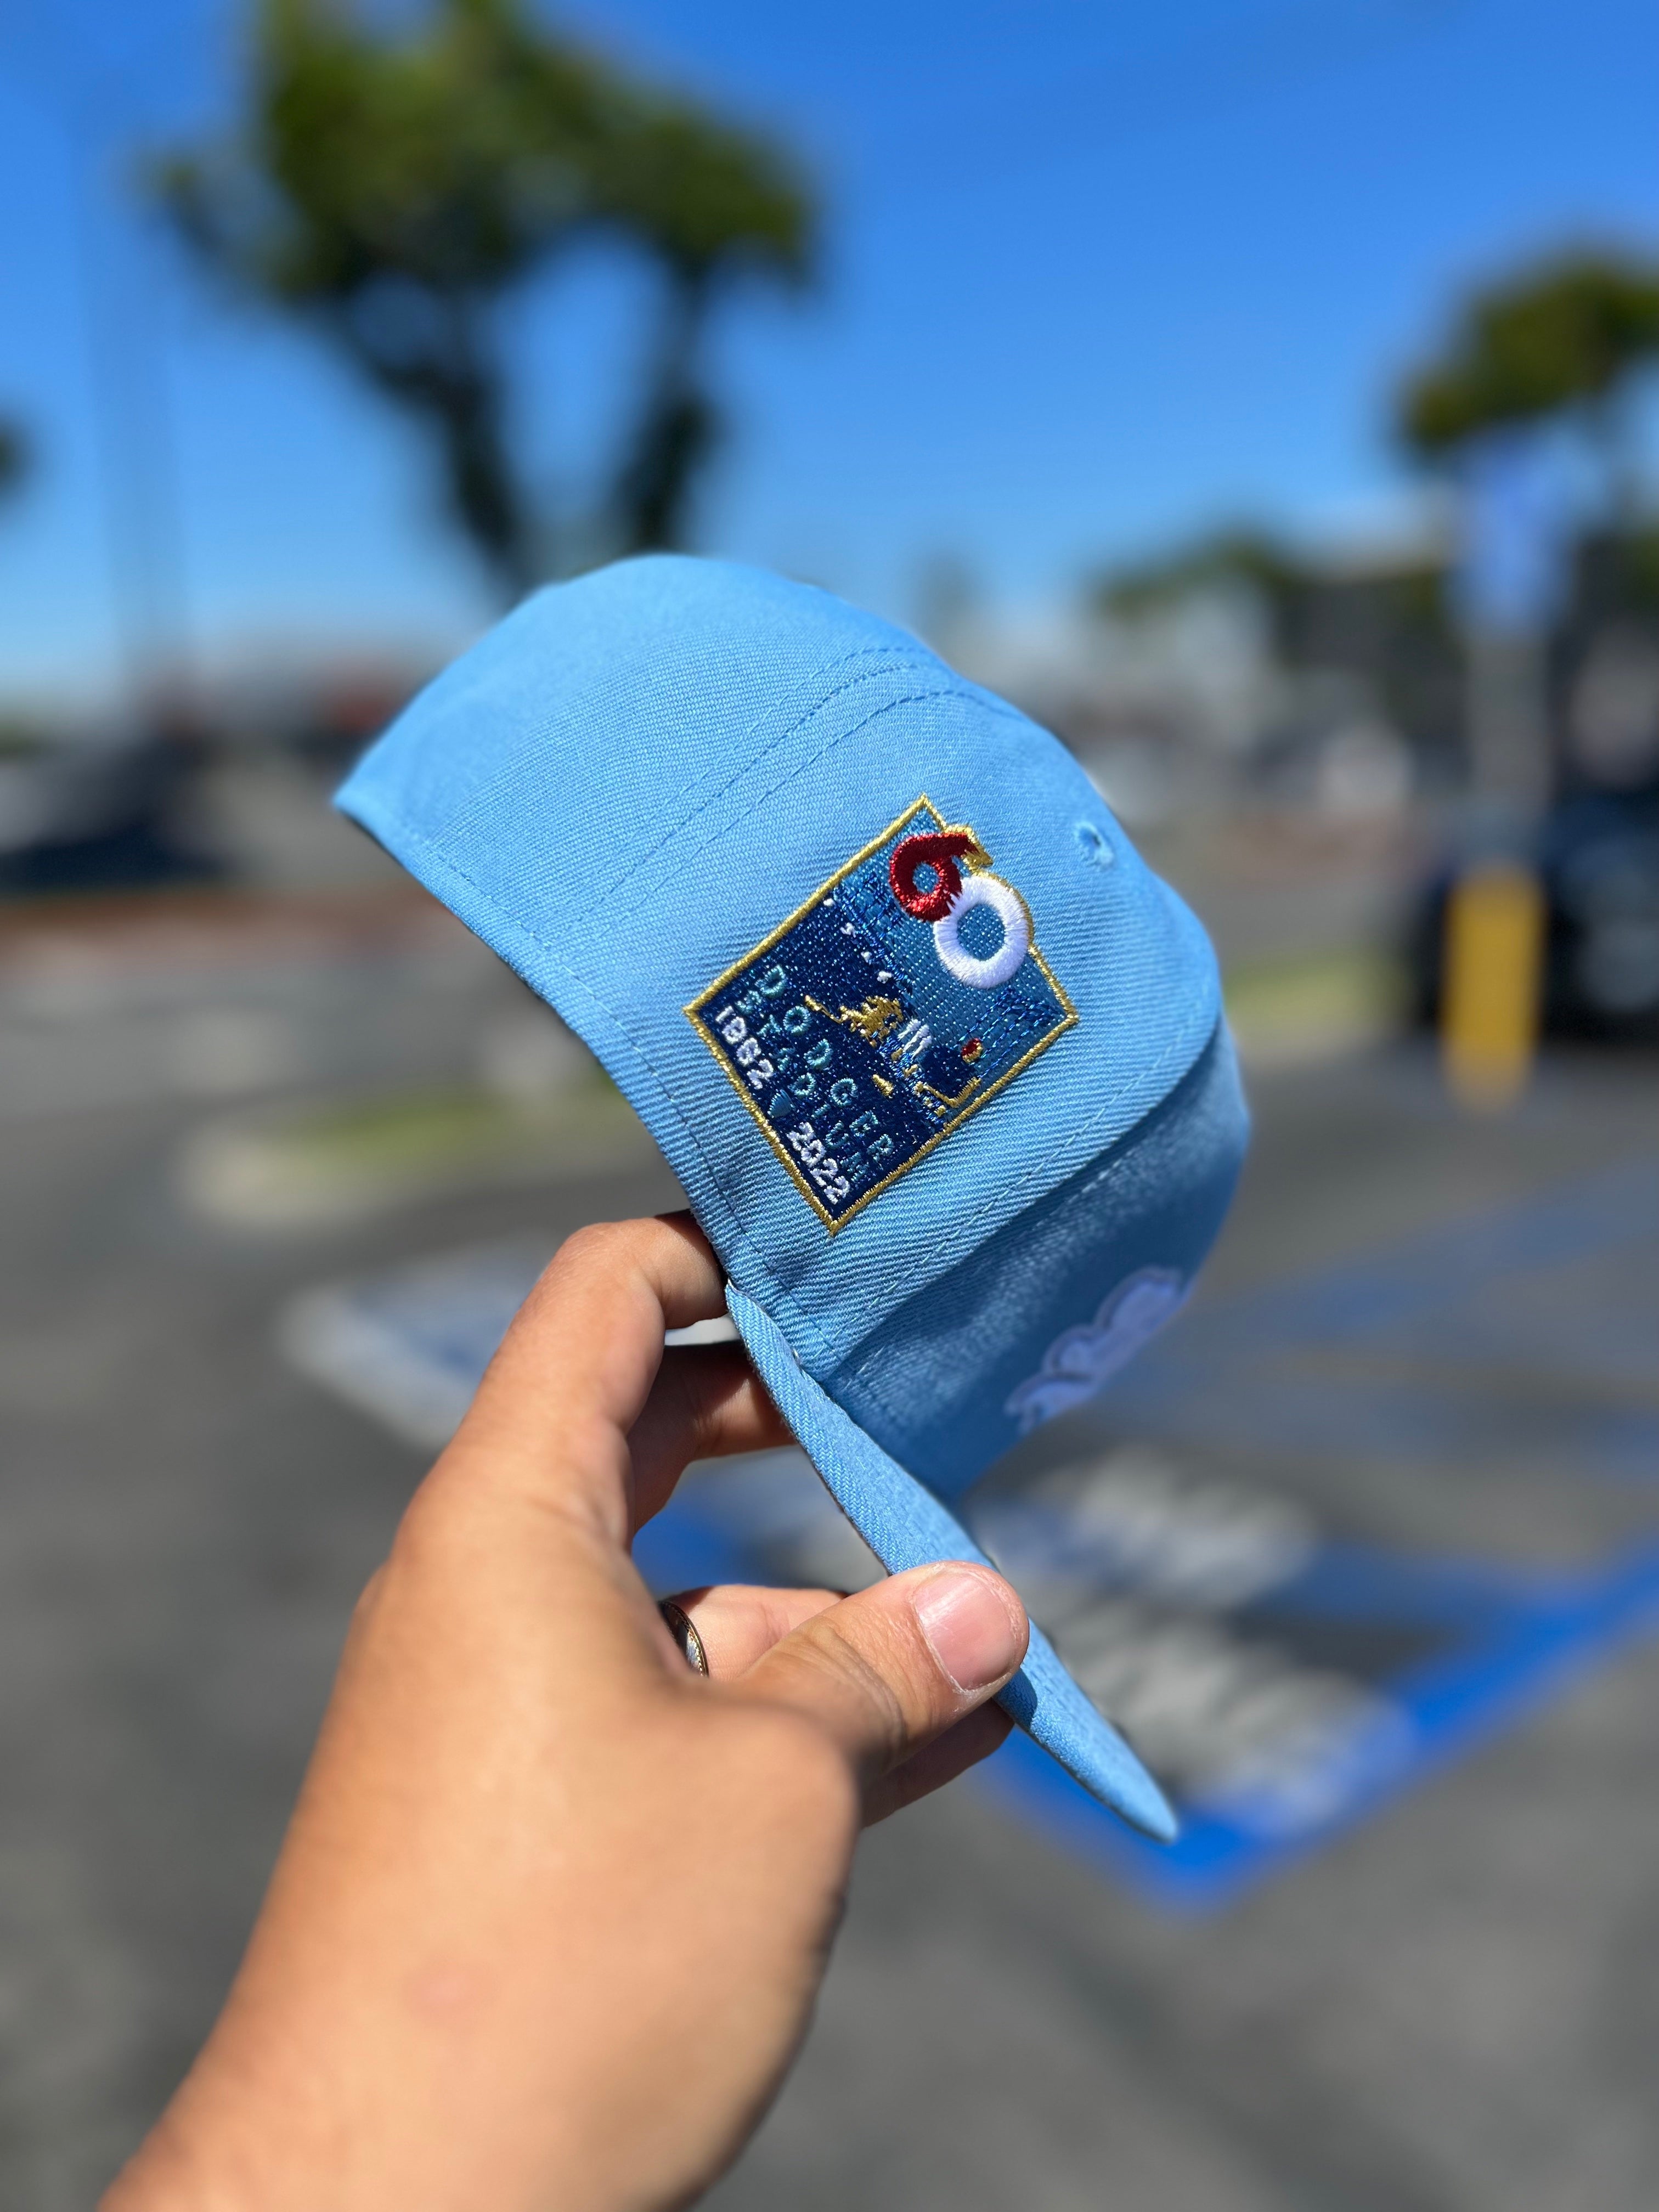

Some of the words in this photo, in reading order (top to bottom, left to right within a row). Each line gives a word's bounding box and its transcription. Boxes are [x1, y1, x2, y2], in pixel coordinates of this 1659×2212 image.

[888, 832, 1030, 989] 60
[735, 990, 870, 1183] STADIUM
[755, 964, 895, 1163] DODGER
[787, 1121, 850, 1205] 2022
